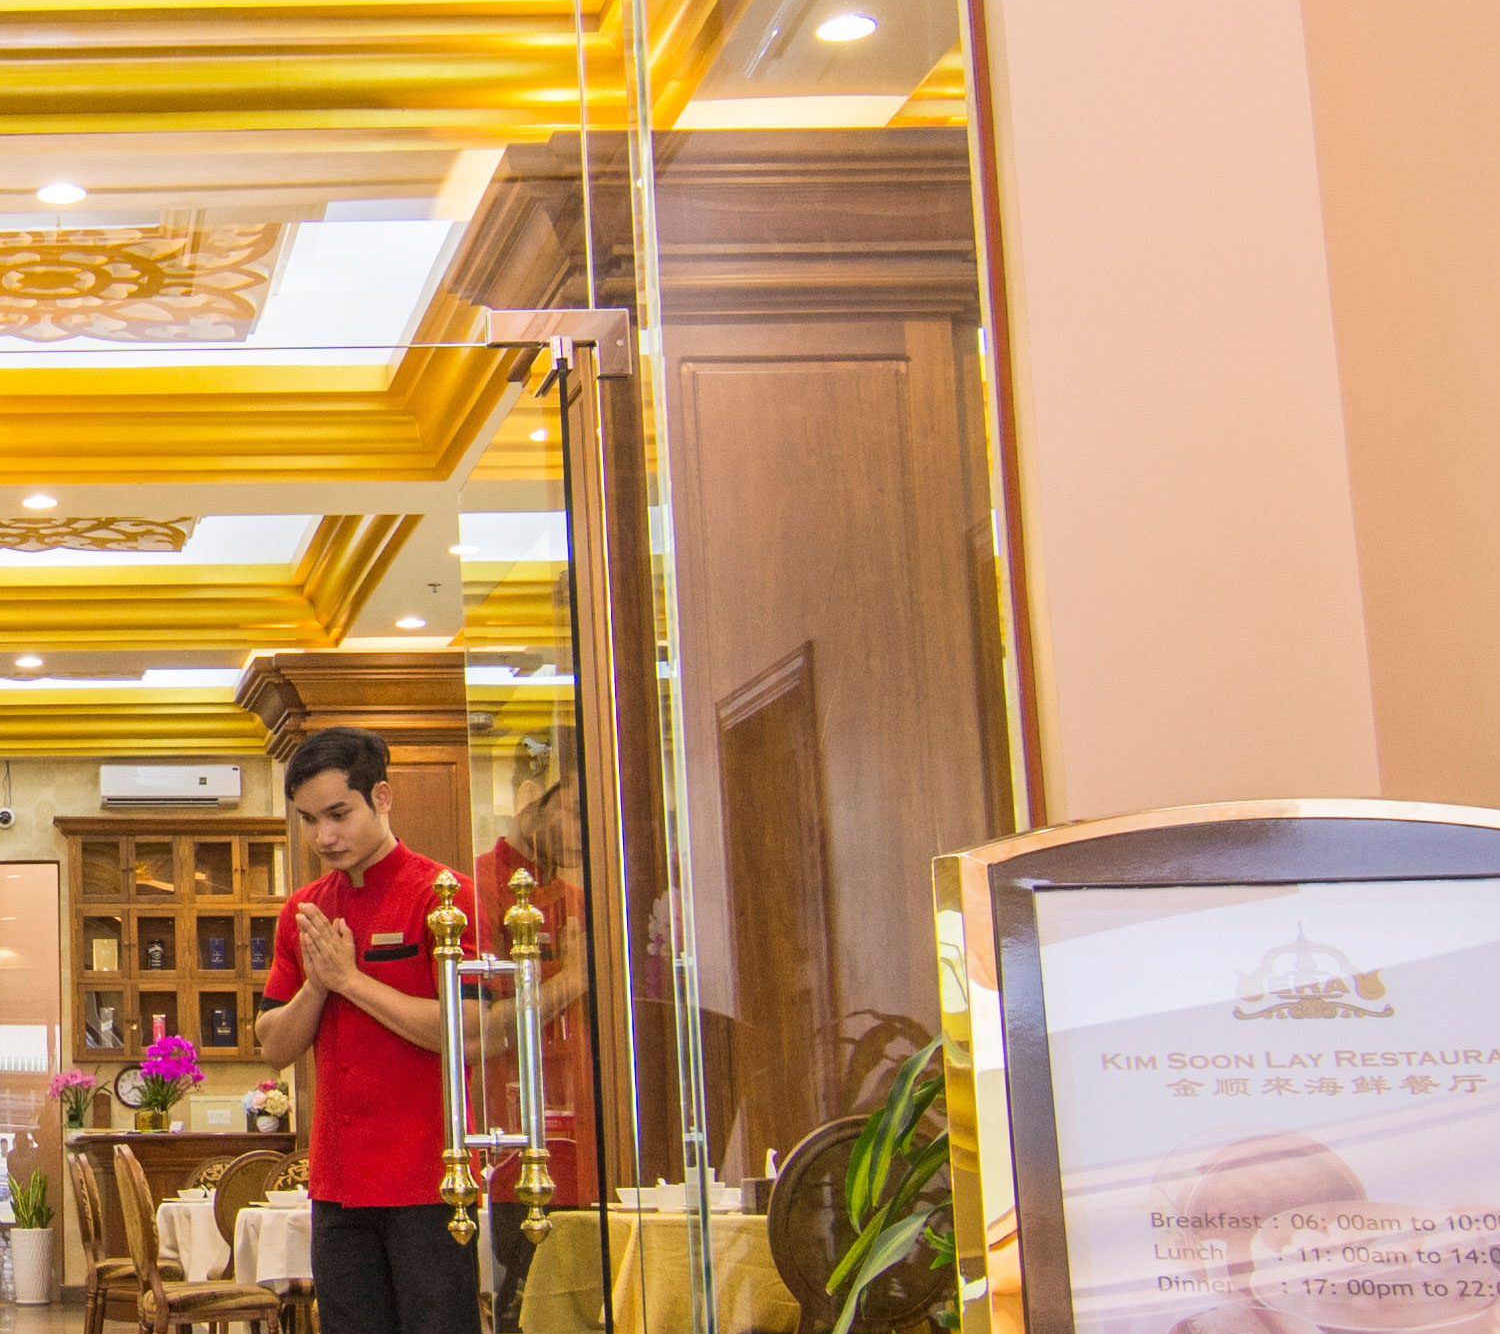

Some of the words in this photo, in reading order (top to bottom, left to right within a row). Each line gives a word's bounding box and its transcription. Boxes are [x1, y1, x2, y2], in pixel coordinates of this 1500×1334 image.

[1165, 1074, 1488, 1097] 金顺來海鲜餐厅
[1151, 1211, 1262, 1229] Breakfast
[1411, 1216, 1436, 1232] to
[1154, 1243, 1224, 1261] Lunch
[1416, 1247, 1442, 1264] to
[1158, 1275, 1232, 1293] Dinner
[1423, 1280, 1449, 1297] to
